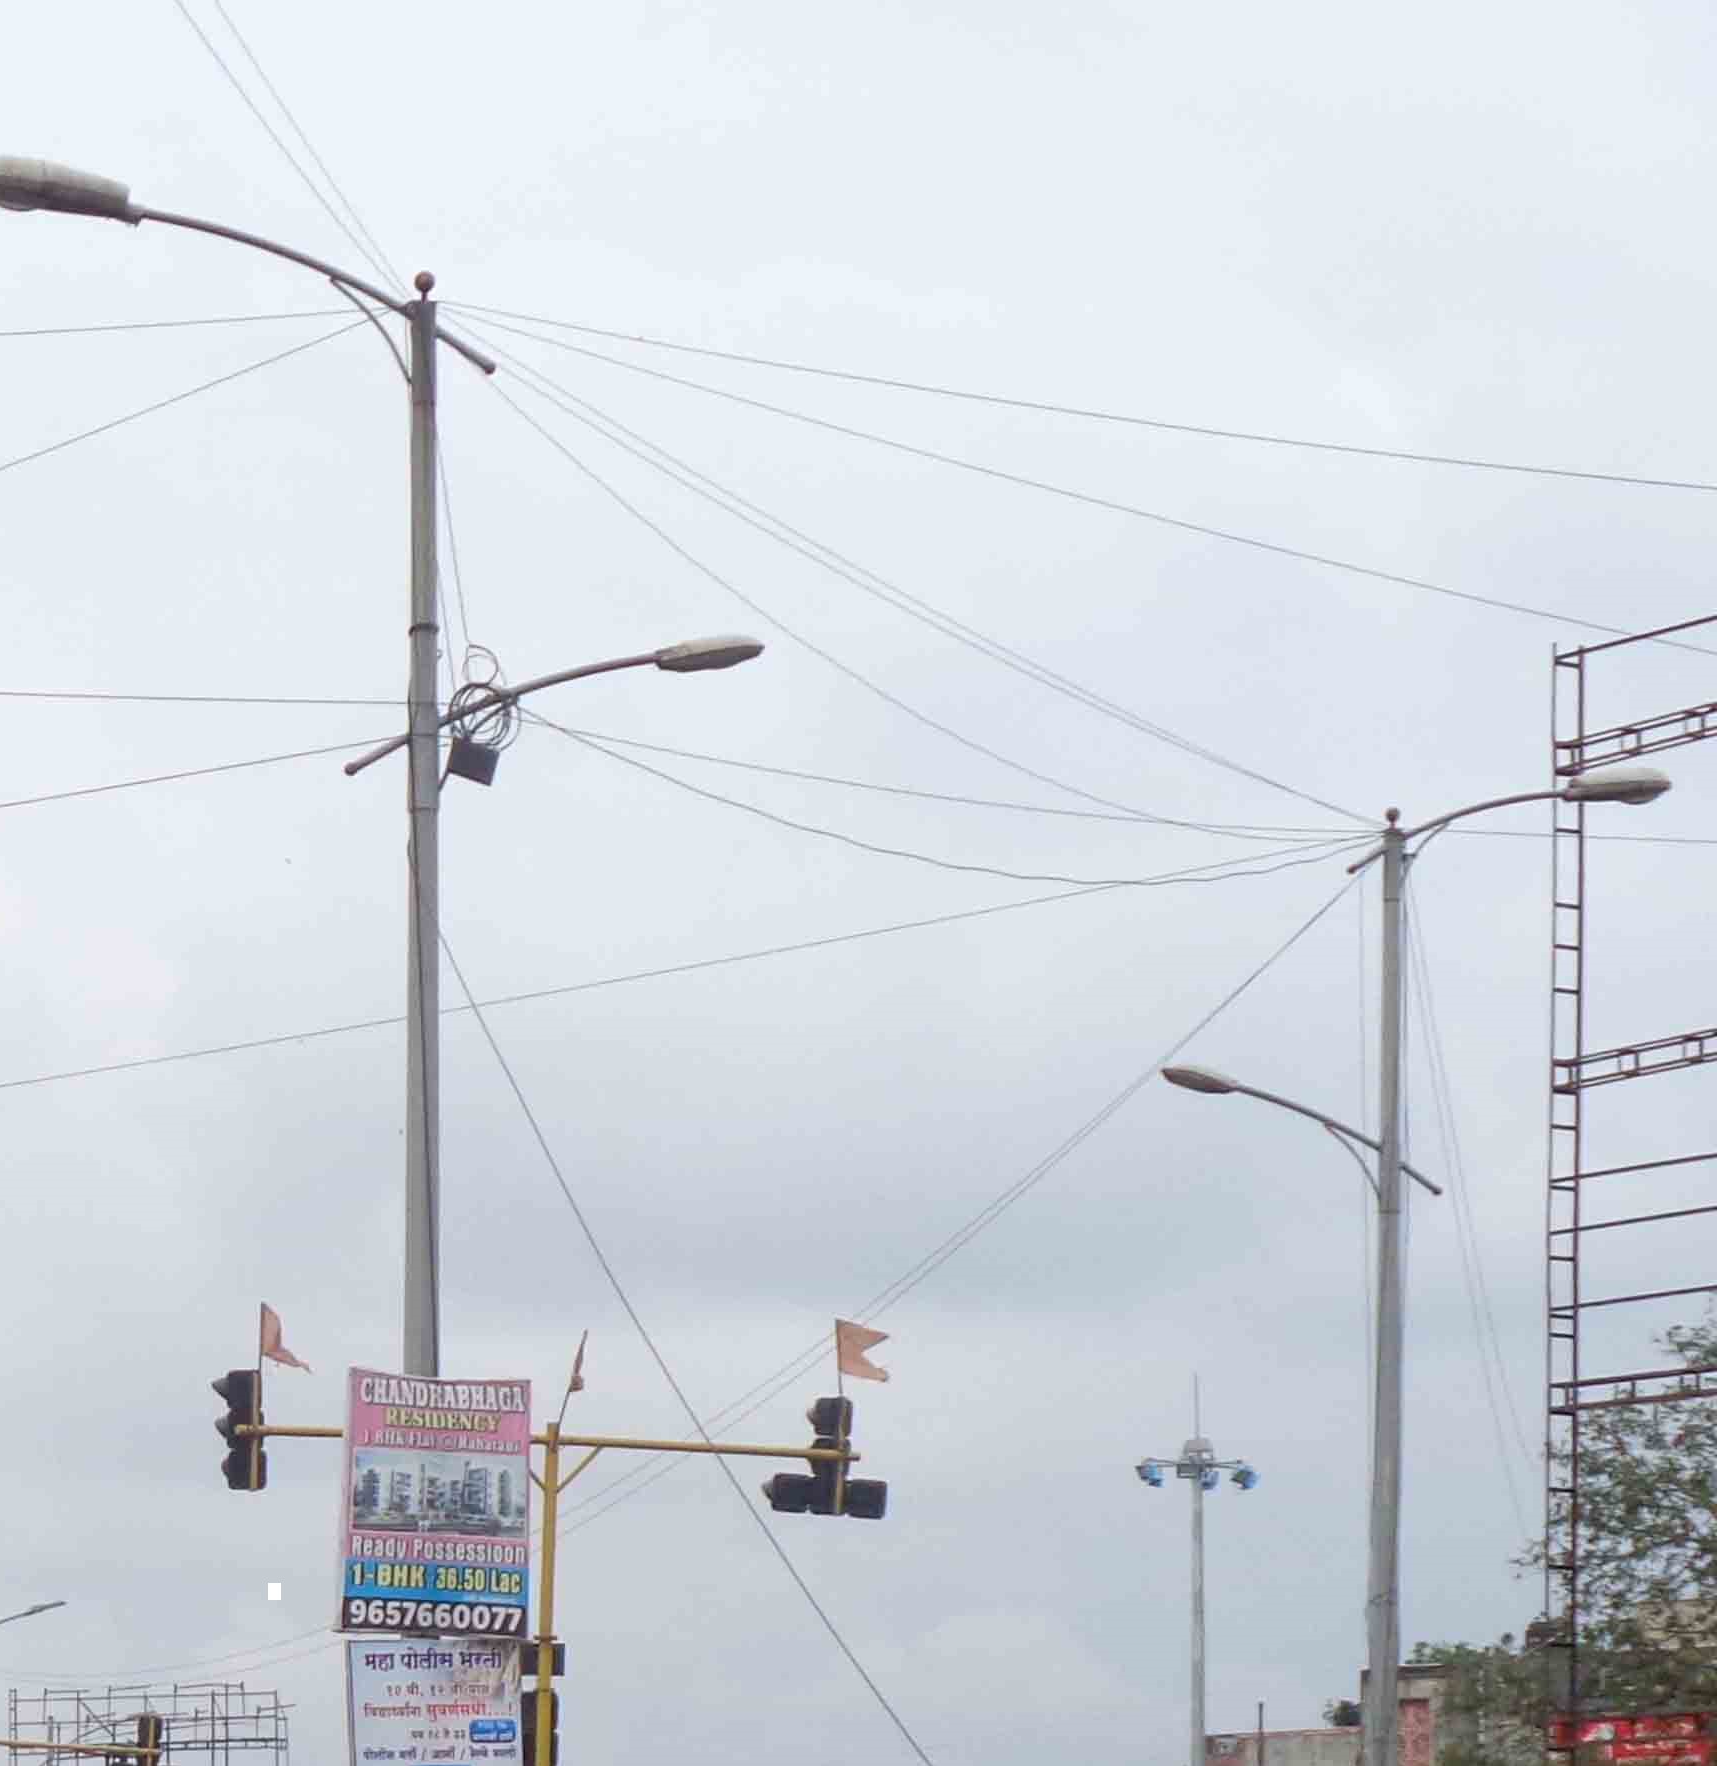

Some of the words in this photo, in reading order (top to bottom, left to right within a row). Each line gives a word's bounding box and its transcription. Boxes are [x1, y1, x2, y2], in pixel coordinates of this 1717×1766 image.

[385, 1408, 501, 1432] RESIDENCY
[352, 1536, 407, 1558] Ready
[353, 1563, 426, 1588] 1-BHK
[491, 1570, 521, 1593] Lac
[349, 1599, 523, 1631] 9657660077
[364, 1652, 394, 1671] महा
